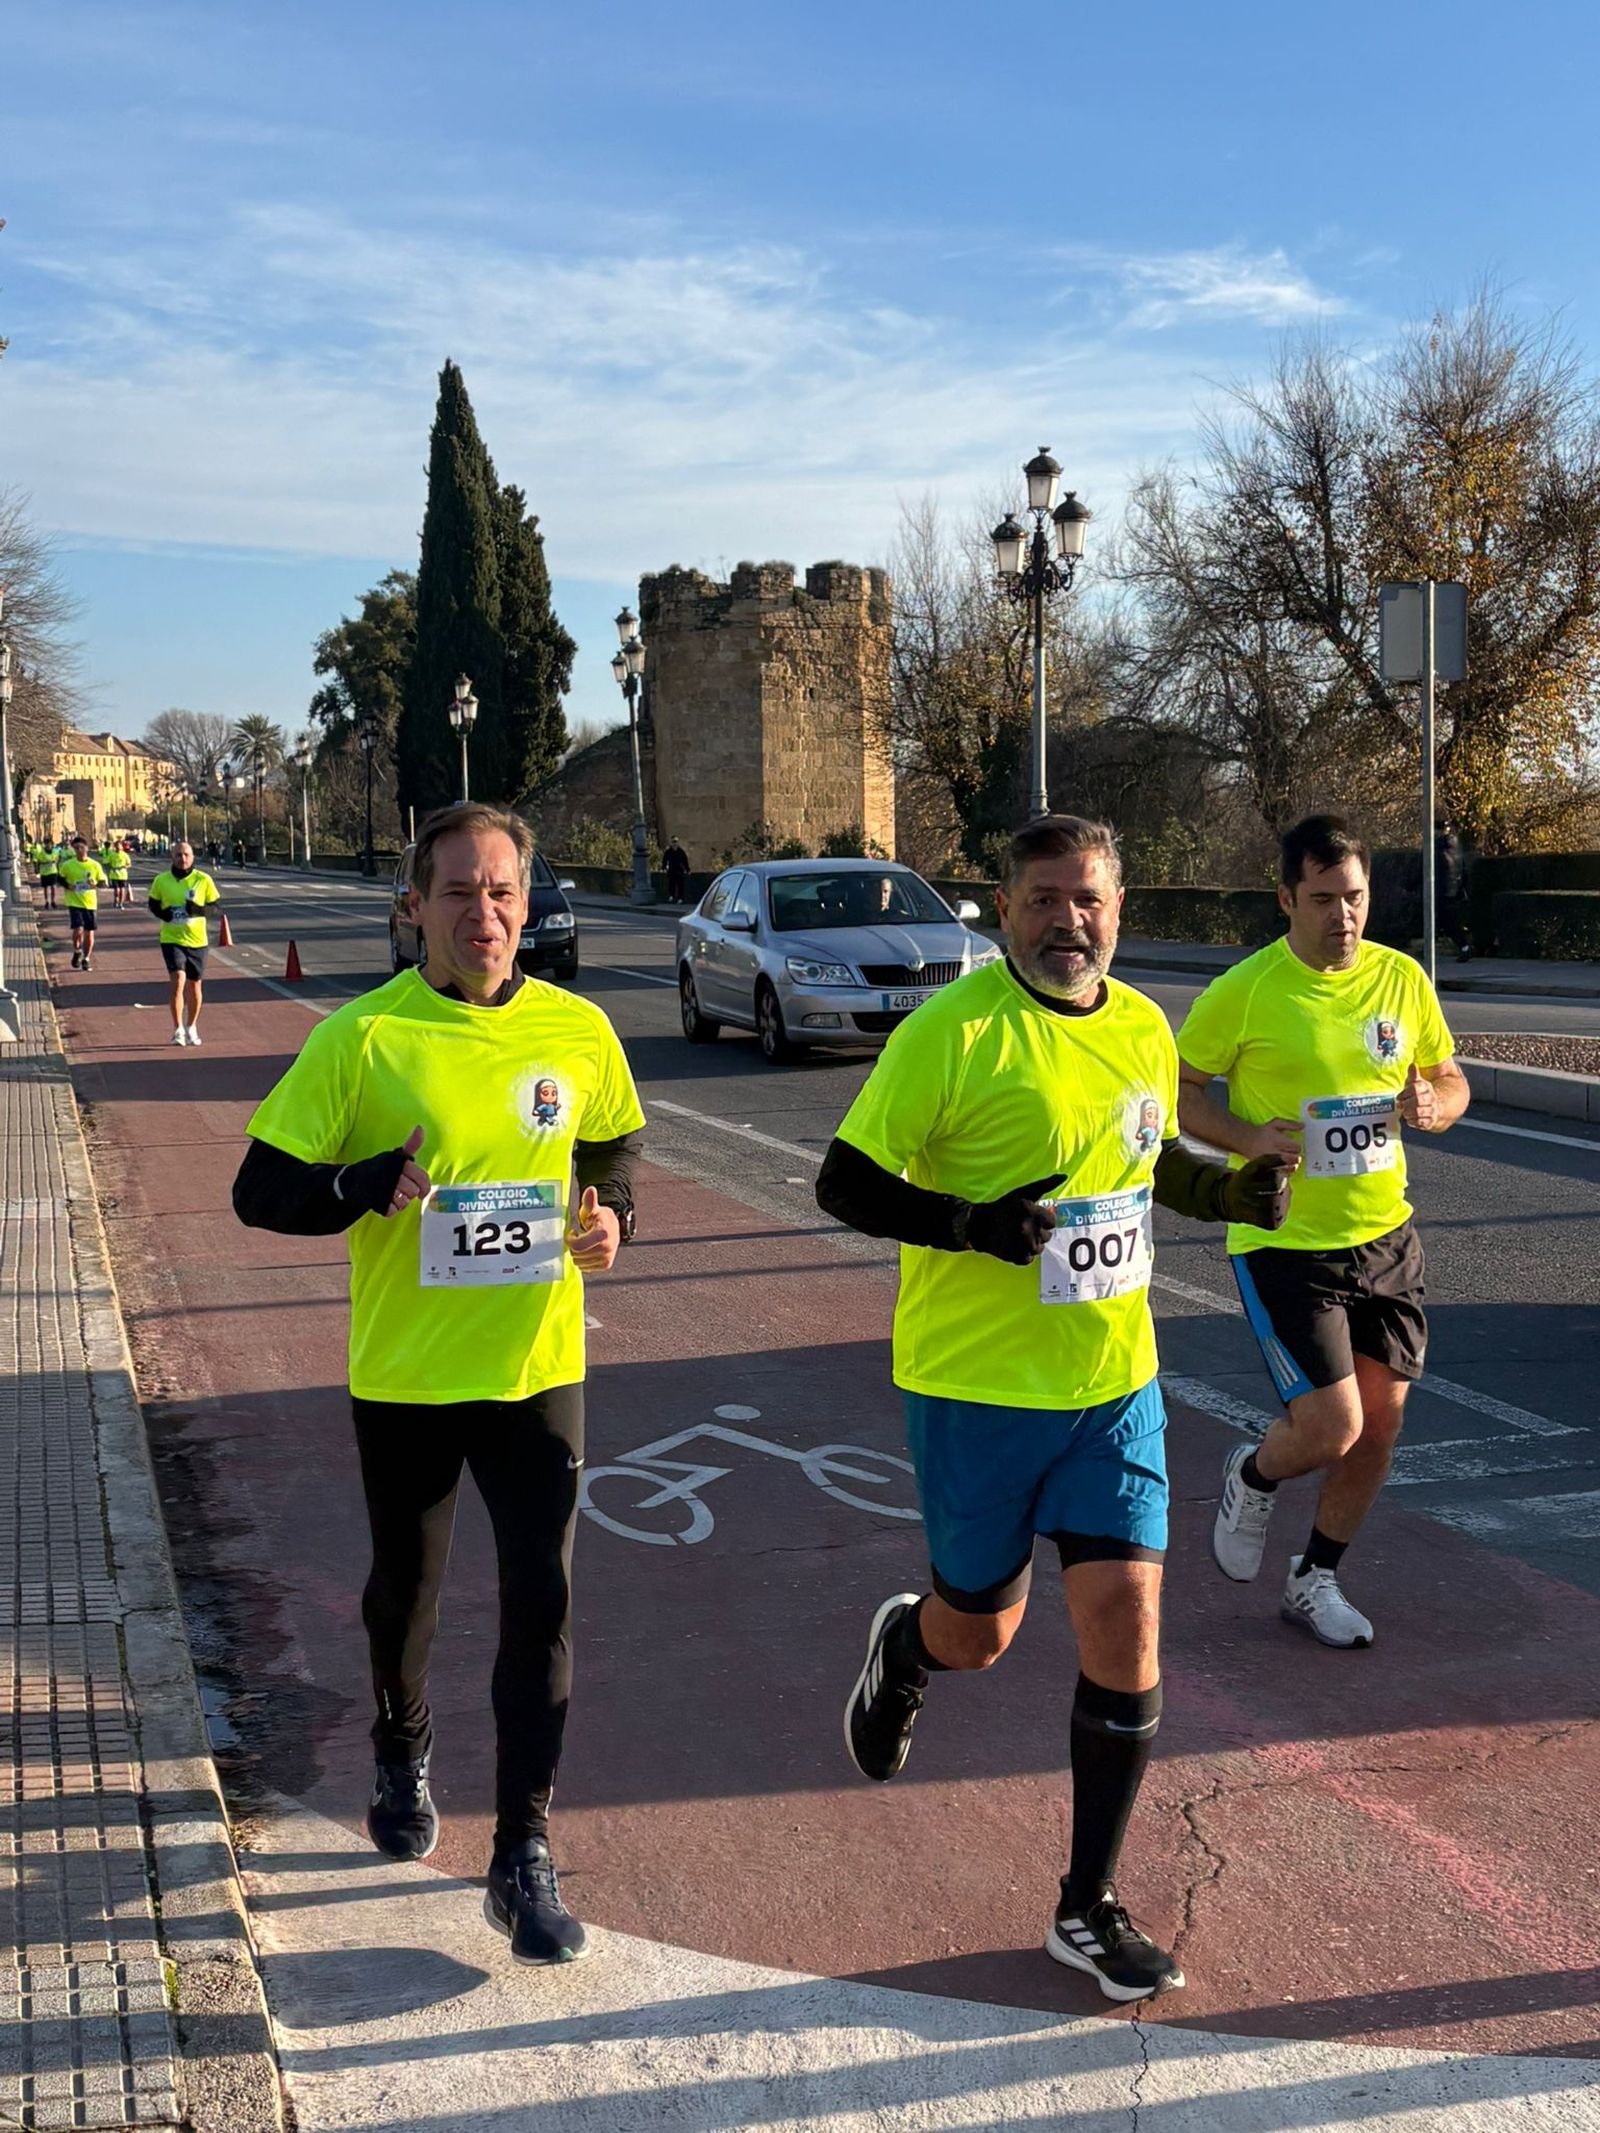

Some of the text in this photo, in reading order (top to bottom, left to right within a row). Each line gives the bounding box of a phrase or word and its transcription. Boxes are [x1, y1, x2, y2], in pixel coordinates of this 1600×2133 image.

[1325, 1122, 1387, 1153] 005
[478, 1188, 529, 1200] COLEGIO
[458, 1201, 496, 1212] DIVINA
[1075, 1212, 1112, 1225] DIVINA
[452, 1220, 532, 1256] 123
[1068, 1227, 1138, 1272] 007
